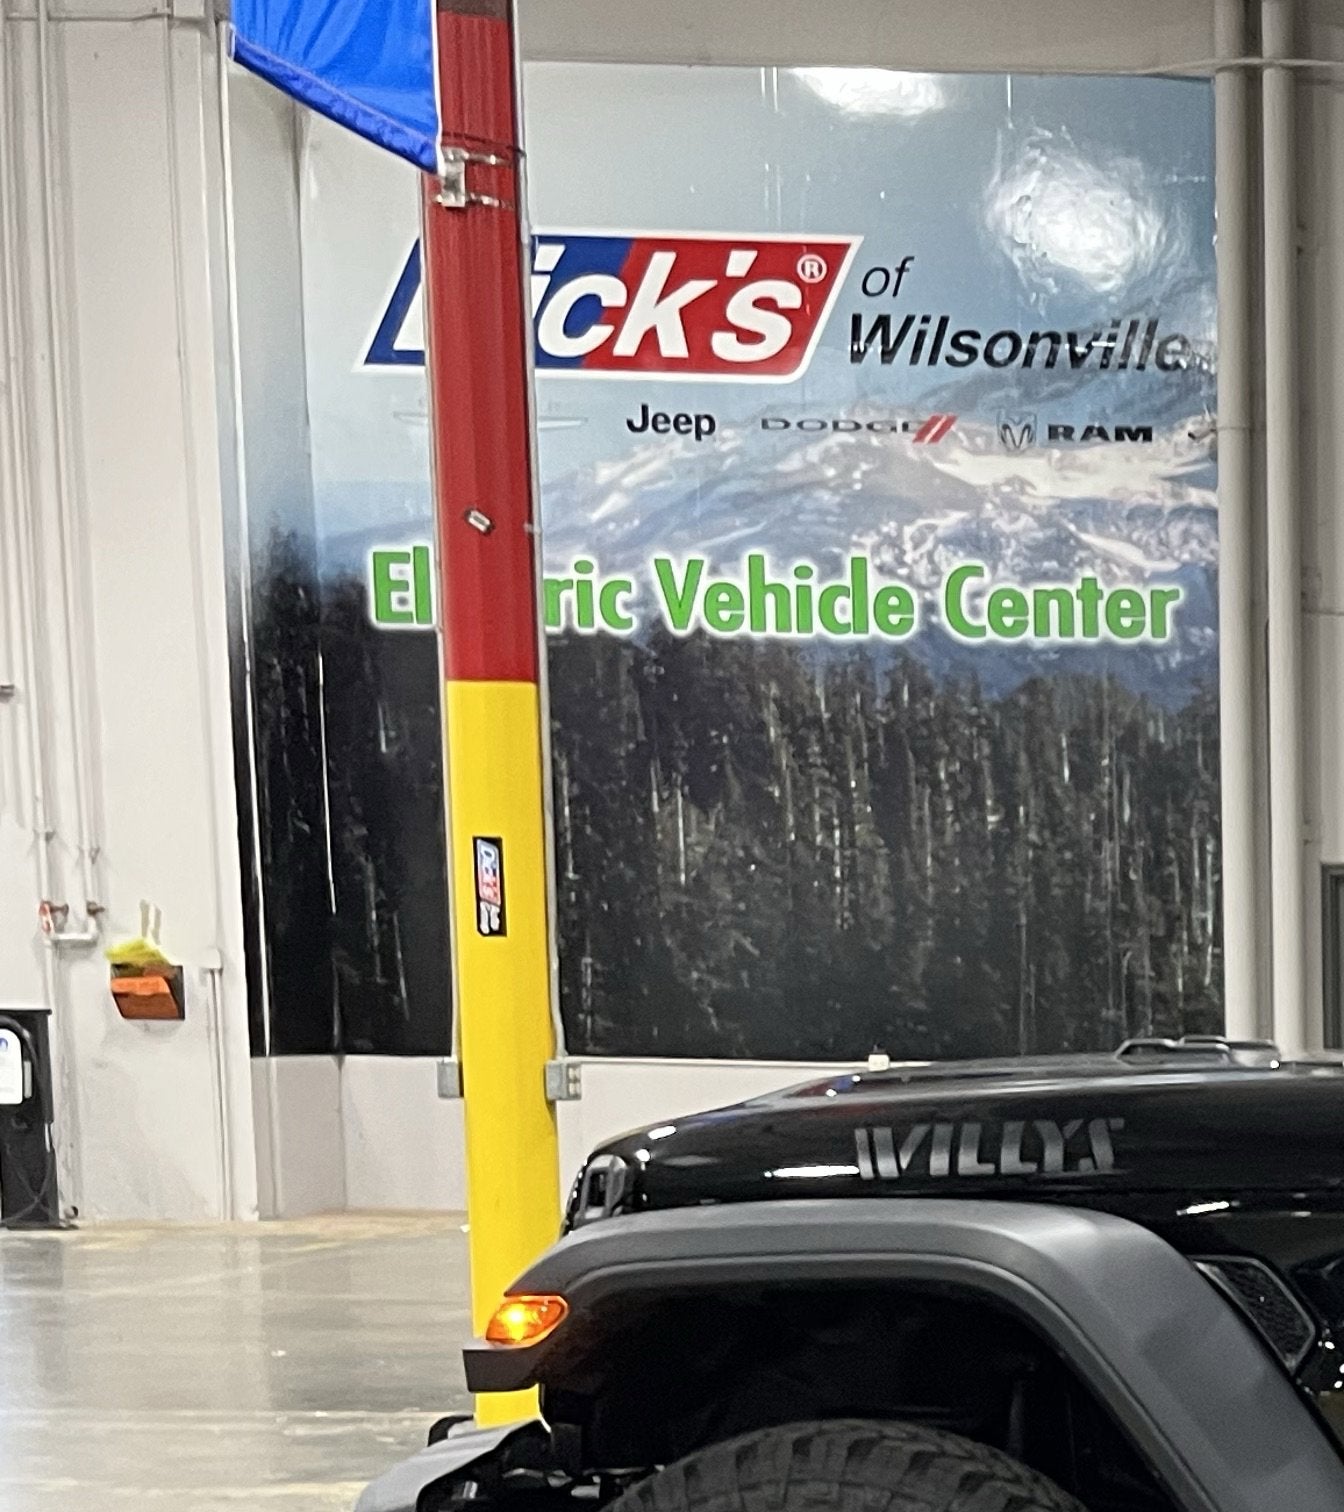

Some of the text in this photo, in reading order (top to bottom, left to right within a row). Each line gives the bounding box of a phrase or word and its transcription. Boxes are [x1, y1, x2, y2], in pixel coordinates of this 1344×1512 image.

[861, 255, 916, 298] of
[848, 312, 1194, 372] Wilsonville
[626, 403, 716, 441] Jeep
[1047, 423, 1154, 443] RAM
[373, 546, 1181, 639] Elric Vehicle Center
[854, 1117, 1125, 1180] WILLYS
